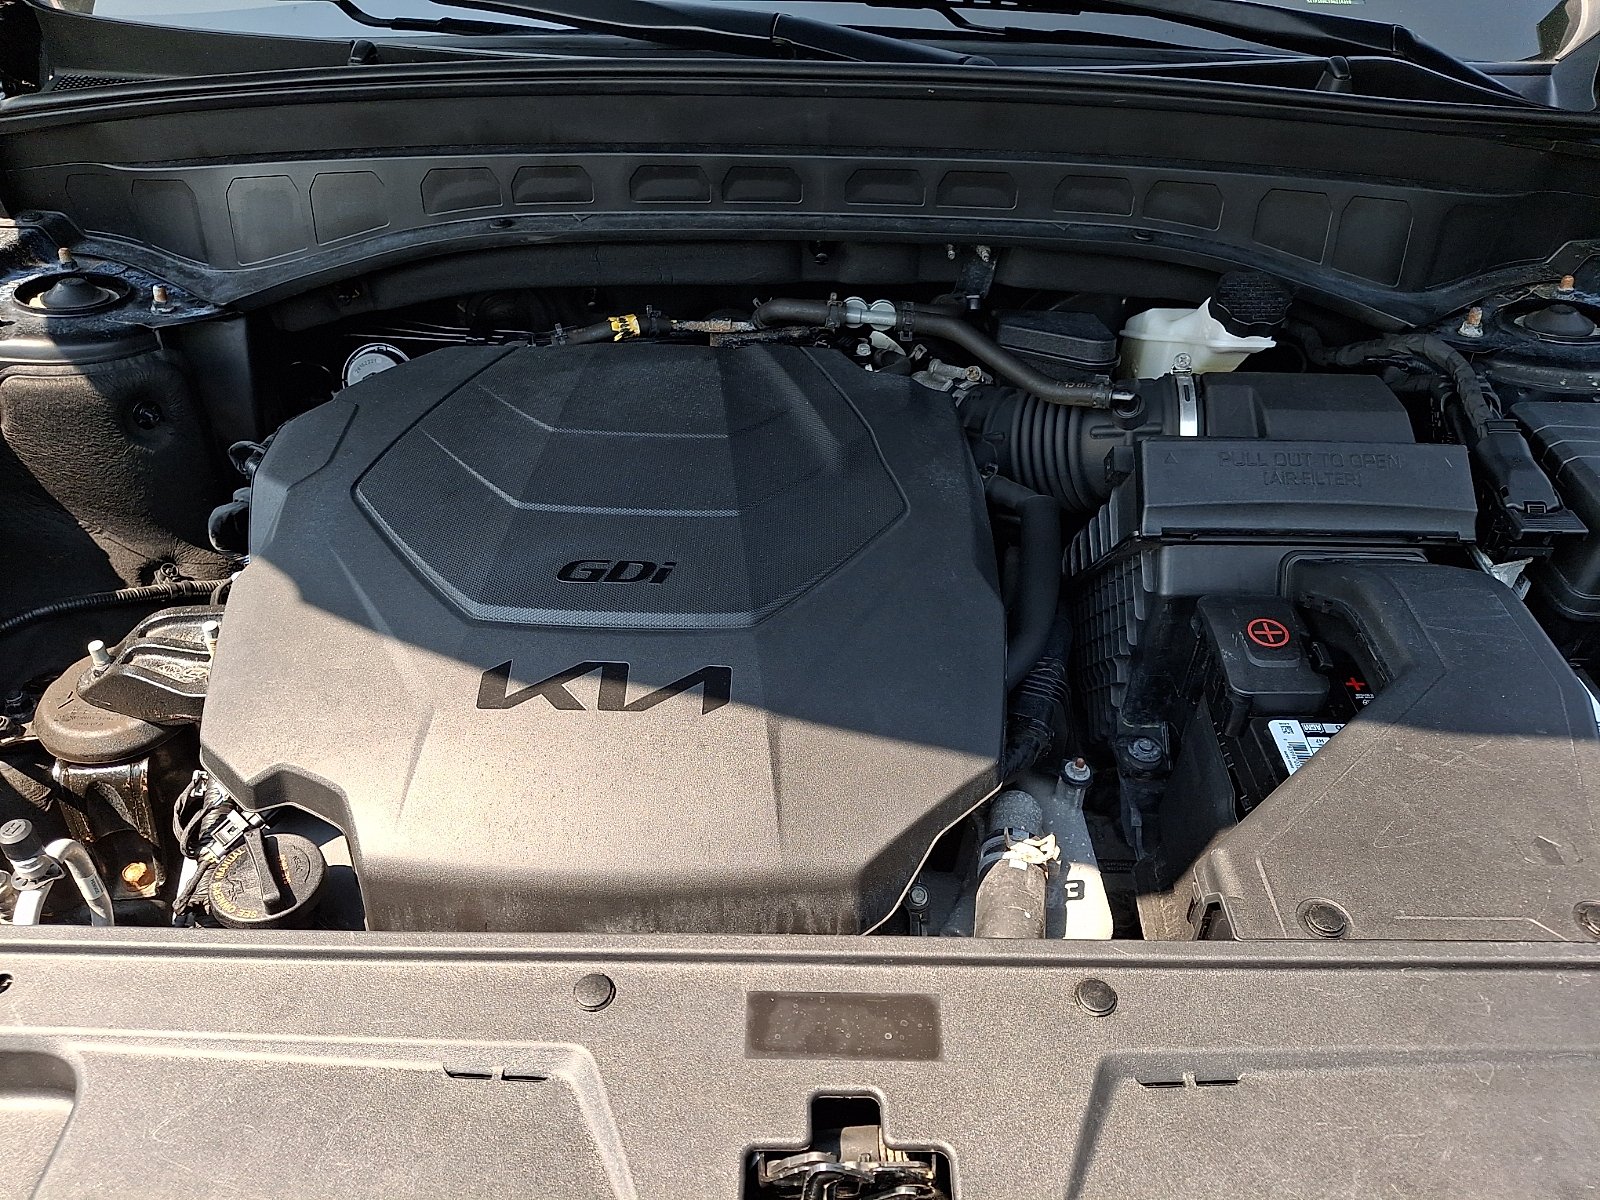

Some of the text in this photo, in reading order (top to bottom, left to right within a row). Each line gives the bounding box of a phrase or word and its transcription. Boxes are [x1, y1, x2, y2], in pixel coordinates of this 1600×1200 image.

[1218, 451, 1402, 469] PULL OUT TO OPEN
[556, 559, 677, 584] GDi
[476, 659, 733, 716] KIA
[214, 847, 247, 880] MANUAL
[236, 908, 258, 919] SEE
